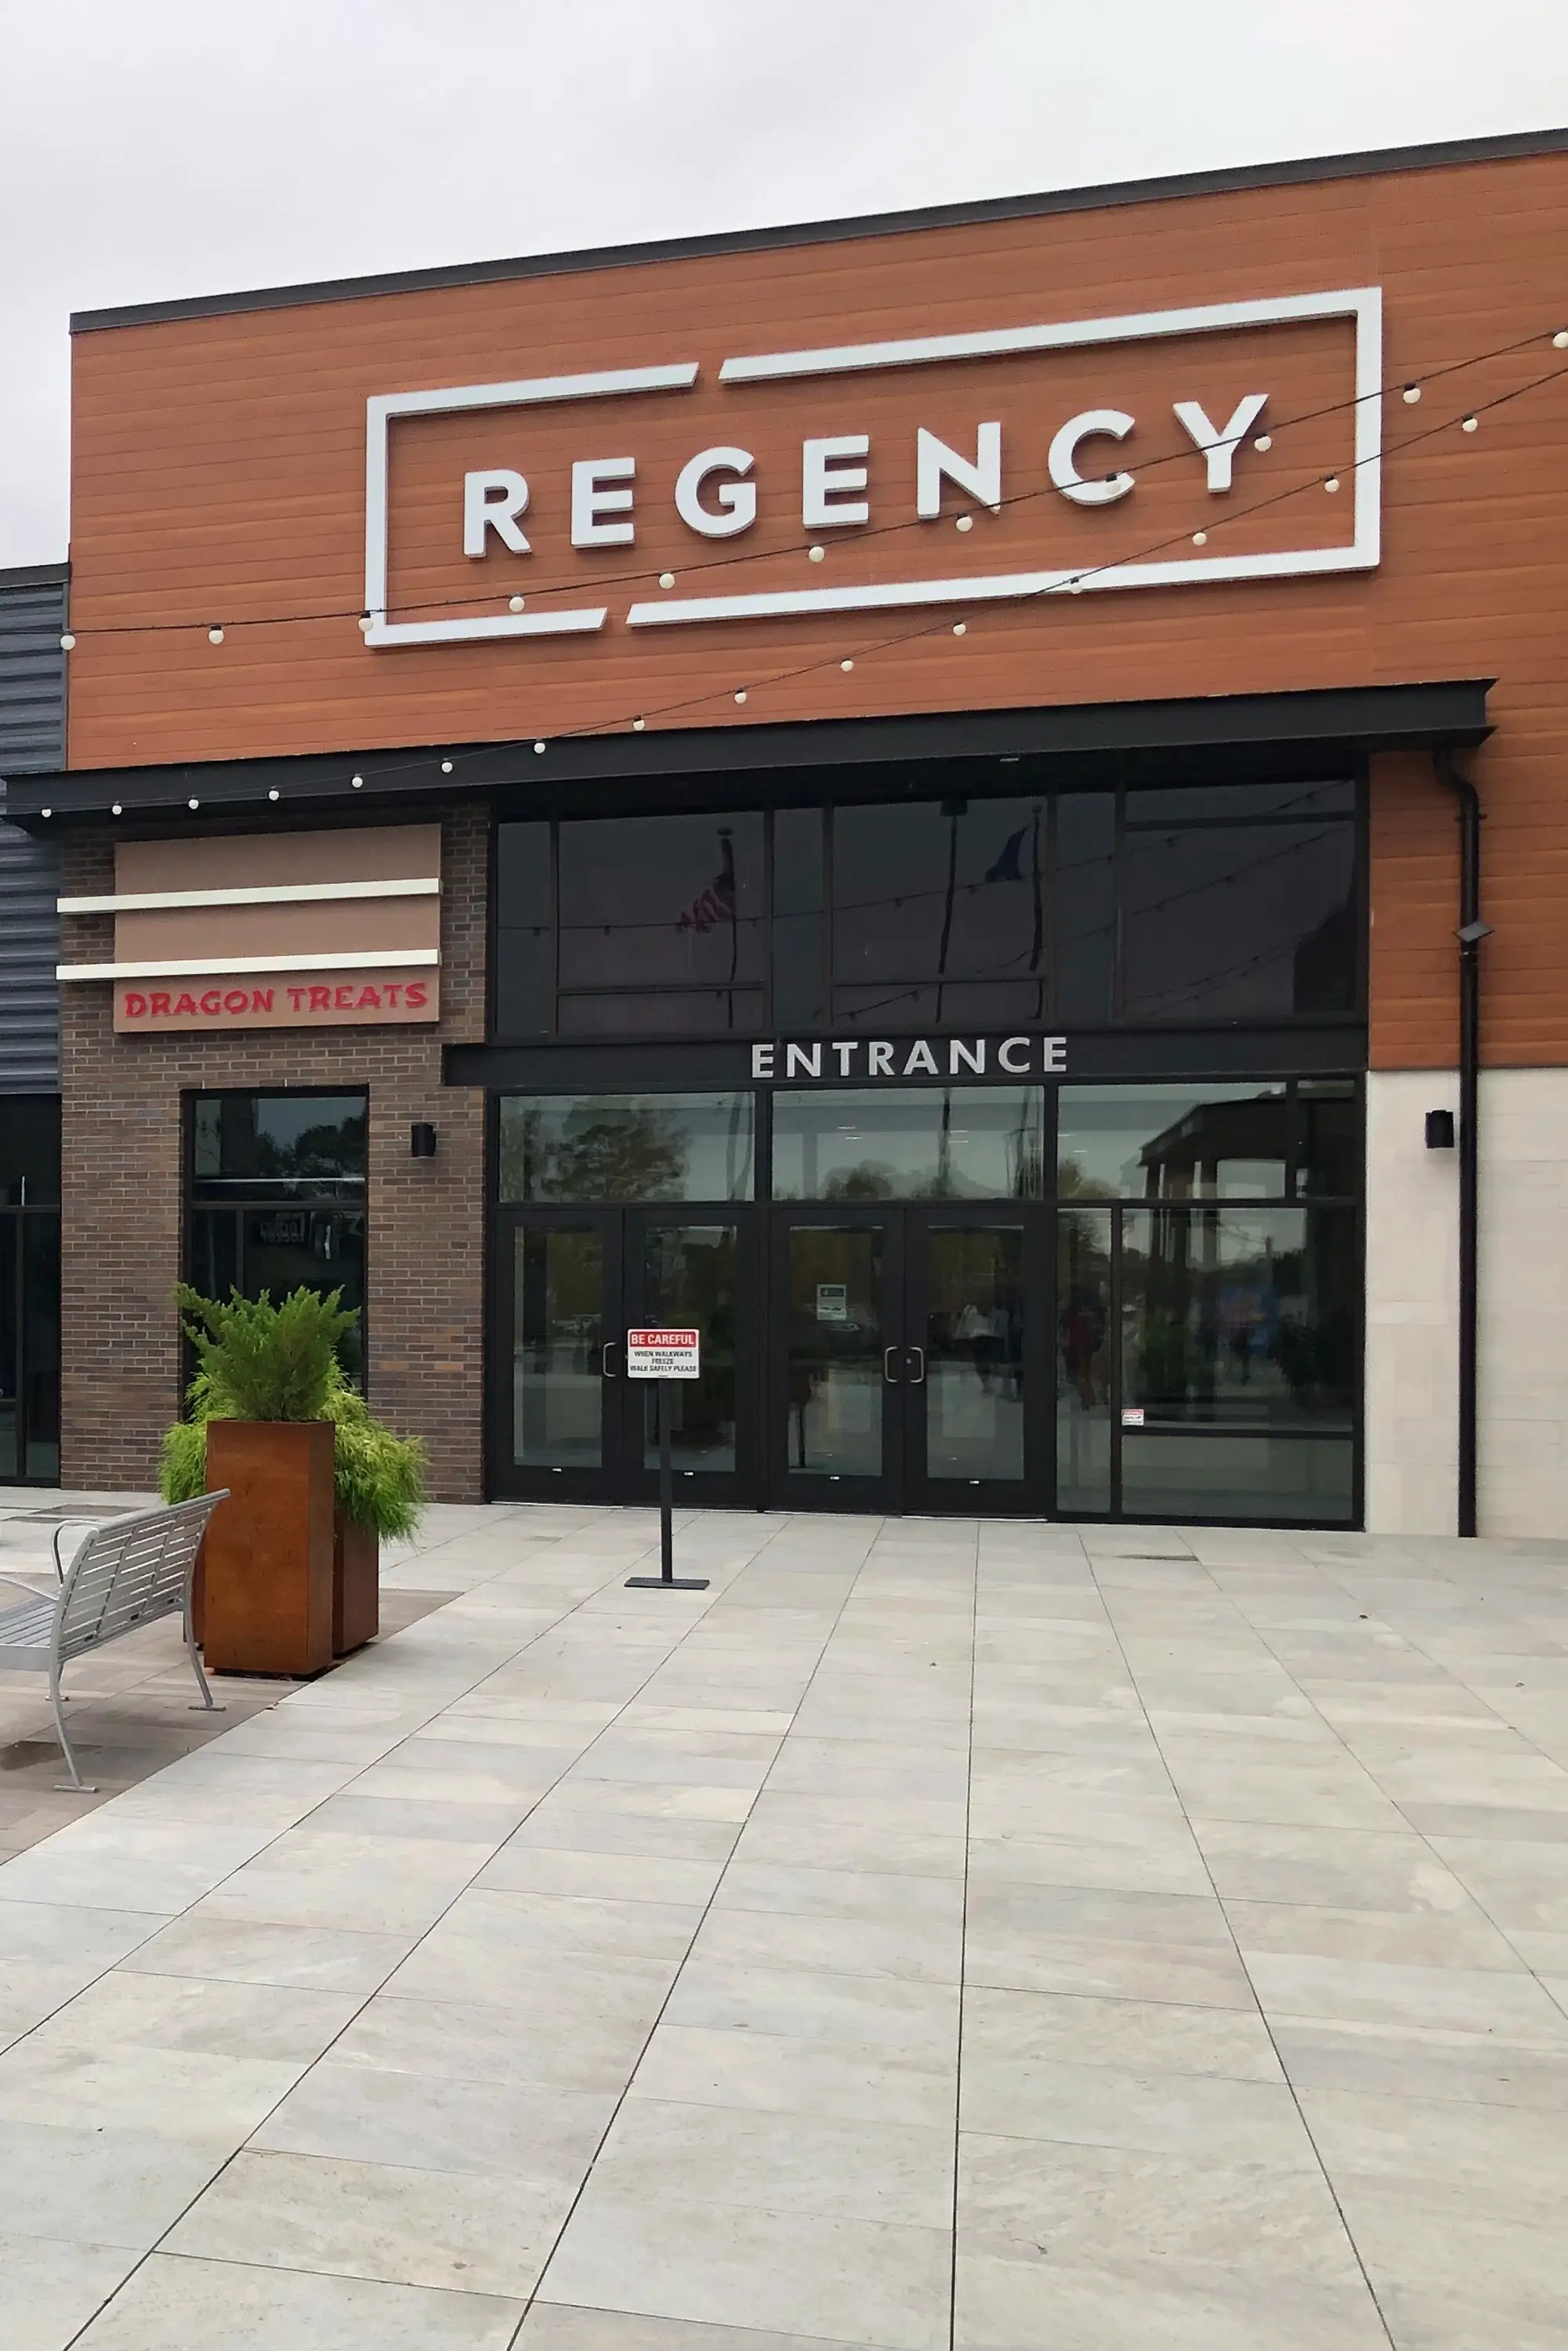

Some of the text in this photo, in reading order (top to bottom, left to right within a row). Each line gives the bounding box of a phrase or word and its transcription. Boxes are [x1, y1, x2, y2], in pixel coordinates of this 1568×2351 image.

[462, 393, 1269, 559] REGENCY
[124, 982, 429, 1019] DRAGON TREATS
[751, 1036, 1068, 1079] ENTRANCE
[631, 1334, 694, 1345] BE CAREFUL
